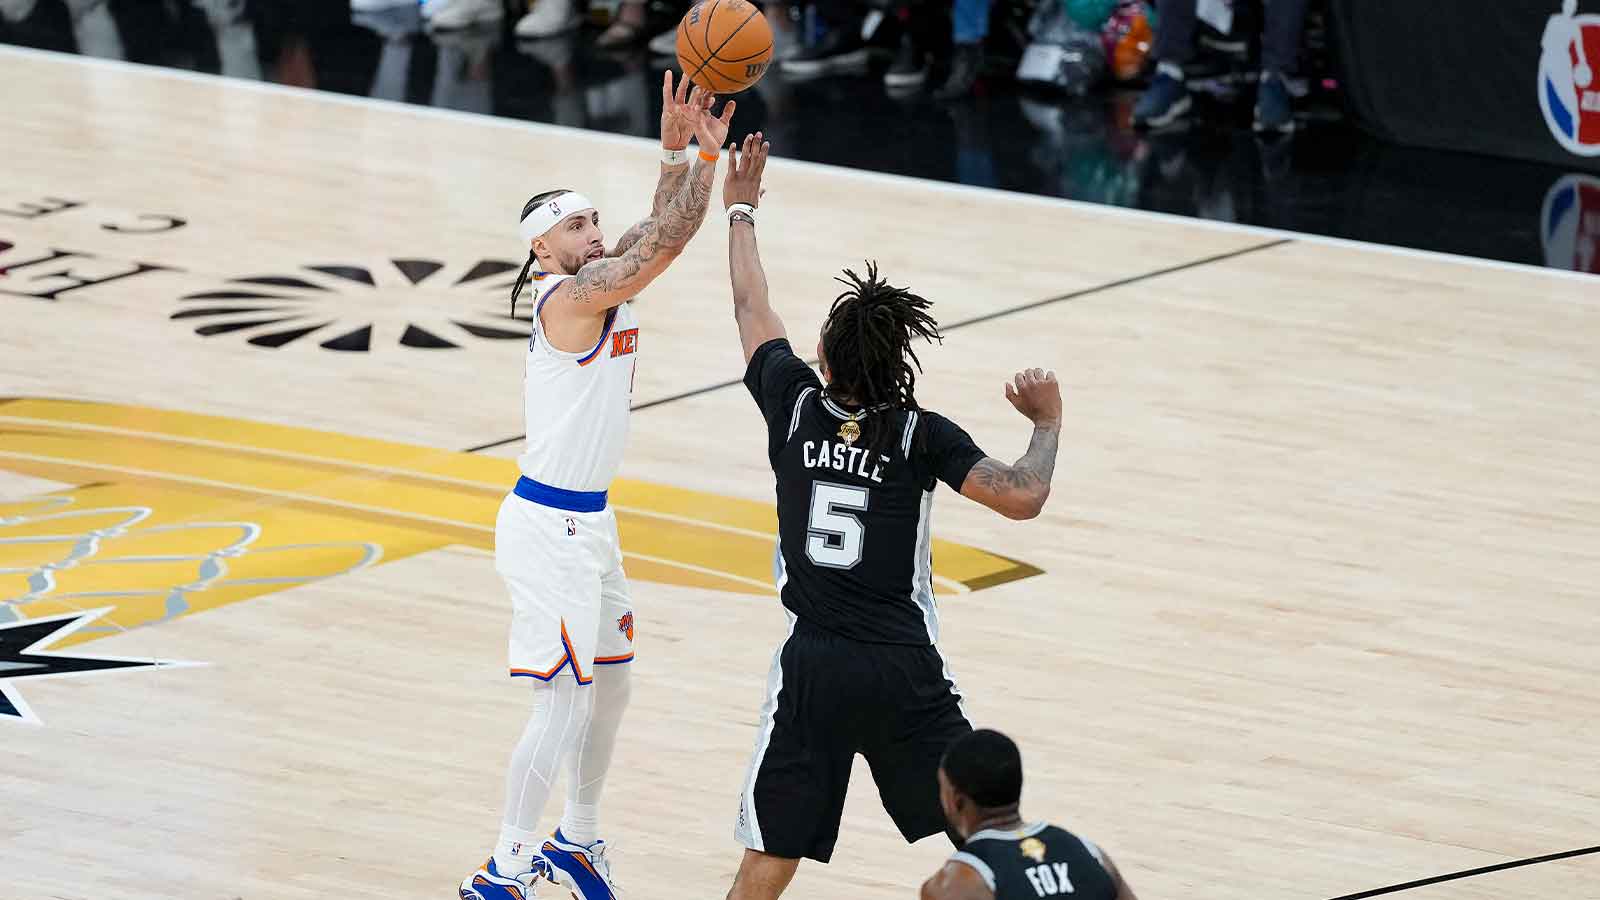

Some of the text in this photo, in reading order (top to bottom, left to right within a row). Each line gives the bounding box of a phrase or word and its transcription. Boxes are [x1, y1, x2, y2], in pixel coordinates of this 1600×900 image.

[610, 328, 639, 358] NE
[805, 480, 869, 570] 5
[1024, 862, 1075, 898] FOX
